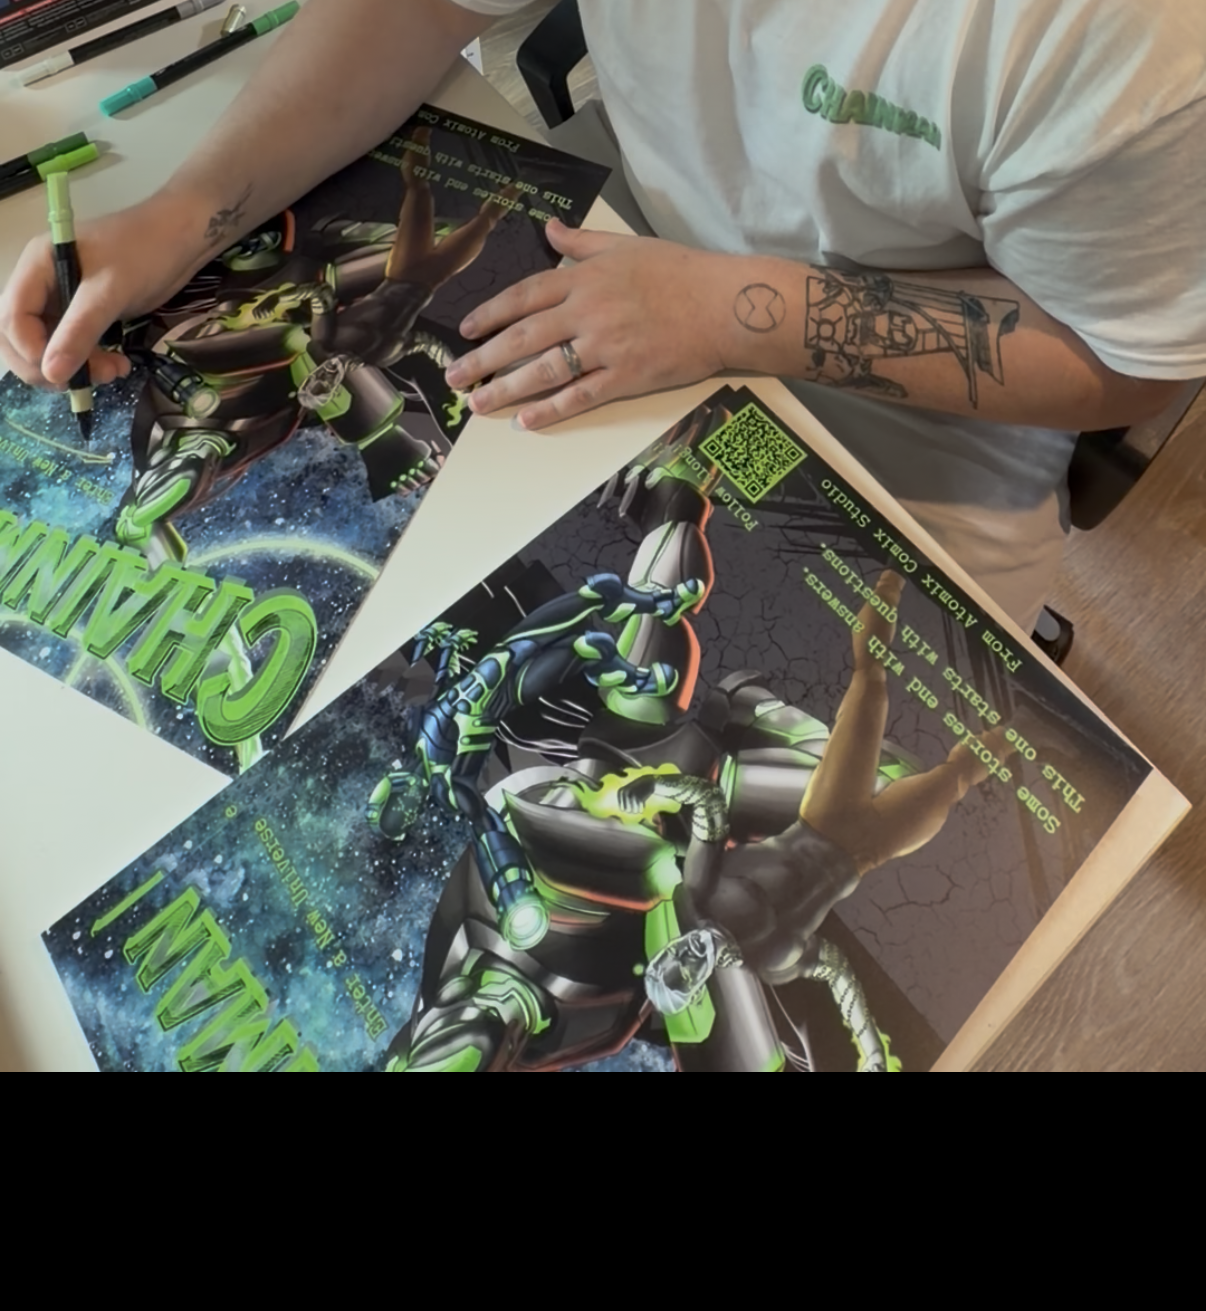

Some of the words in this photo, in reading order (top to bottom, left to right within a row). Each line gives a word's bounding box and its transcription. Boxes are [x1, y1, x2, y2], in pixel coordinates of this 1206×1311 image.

[417, 109, 441, 126] Com
[801, 63, 942, 152] CHAINMAN
[389, 136, 431, 156] questi
[442, 119, 487, 140] Atomix
[490, 134, 521, 154] From
[412, 165, 442, 183] with
[435, 152, 463, 168] with
[467, 164, 511, 185] starts
[444, 177, 469, 192] end
[472, 187, 525, 212] stories
[515, 180, 538, 195] one
[542, 190, 573, 211] This
[528, 208, 554, 223] ome
[0, 437, 29, 462] Univ
[32, 457, 59, 477] New
[61, 469, 73, 481] a
[715, 486, 759, 532] Follow
[820, 477, 871, 528] Studio
[872, 528, 919, 574] Comix
[800, 565, 866, 634] answers.
[817, 541, 898, 626] questions.
[920, 572, 979, 629] Atomix
[865, 634, 907, 678] with
[898, 623, 940, 666] with
[980, 628, 1024, 673] From
[904, 675, 939, 711] end
[941, 665, 1002, 728] starts
[941, 711, 1013, 783] stories
[1004, 727, 1038, 762] one
[1041, 763, 1087, 814] This
[1015, 784, 1062, 835] Some
[253, 818, 309, 907] Universe
[303, 908, 336, 949] New
[331, 949, 347, 967] a
[343, 973, 389, 1042] Enter
